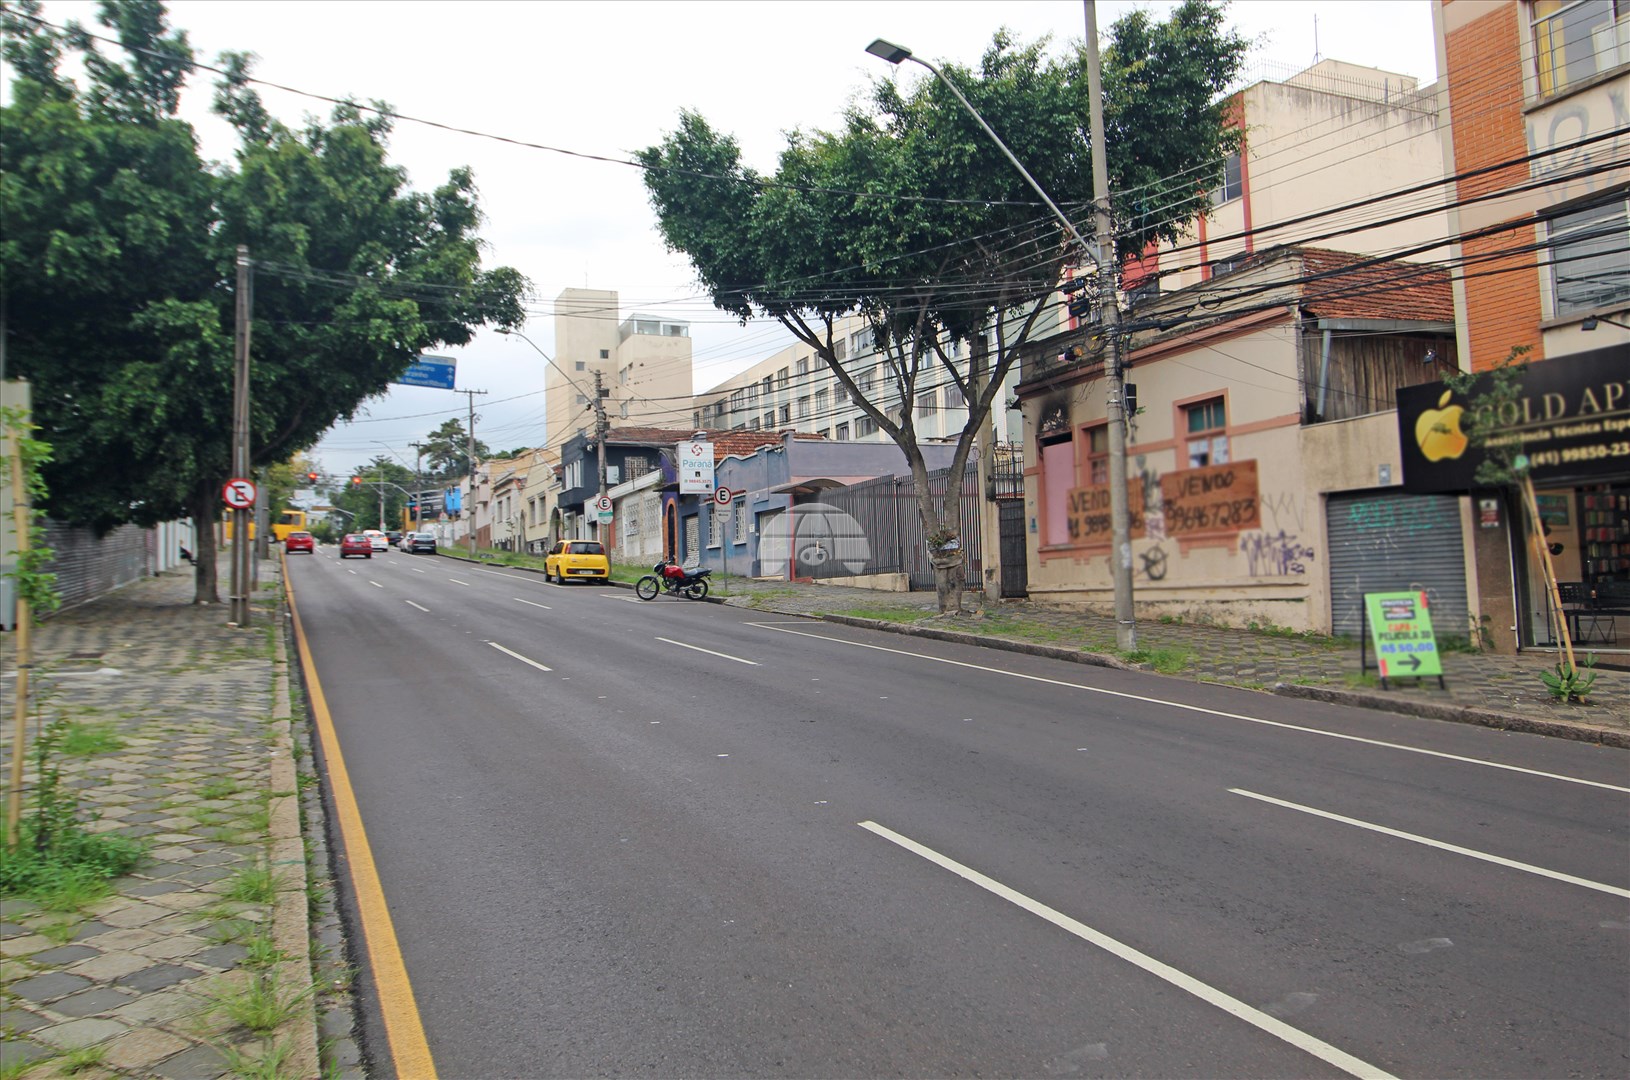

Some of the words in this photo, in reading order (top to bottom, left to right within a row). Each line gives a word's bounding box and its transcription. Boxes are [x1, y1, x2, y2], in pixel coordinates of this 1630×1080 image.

[1578, 382, 1630, 416] AP
[1530, 449, 1560, 468] (41)
[719, 490, 727, 501] E
[1177, 470, 1234, 498] VENDO
[1070, 489, 1112, 513] VEND
